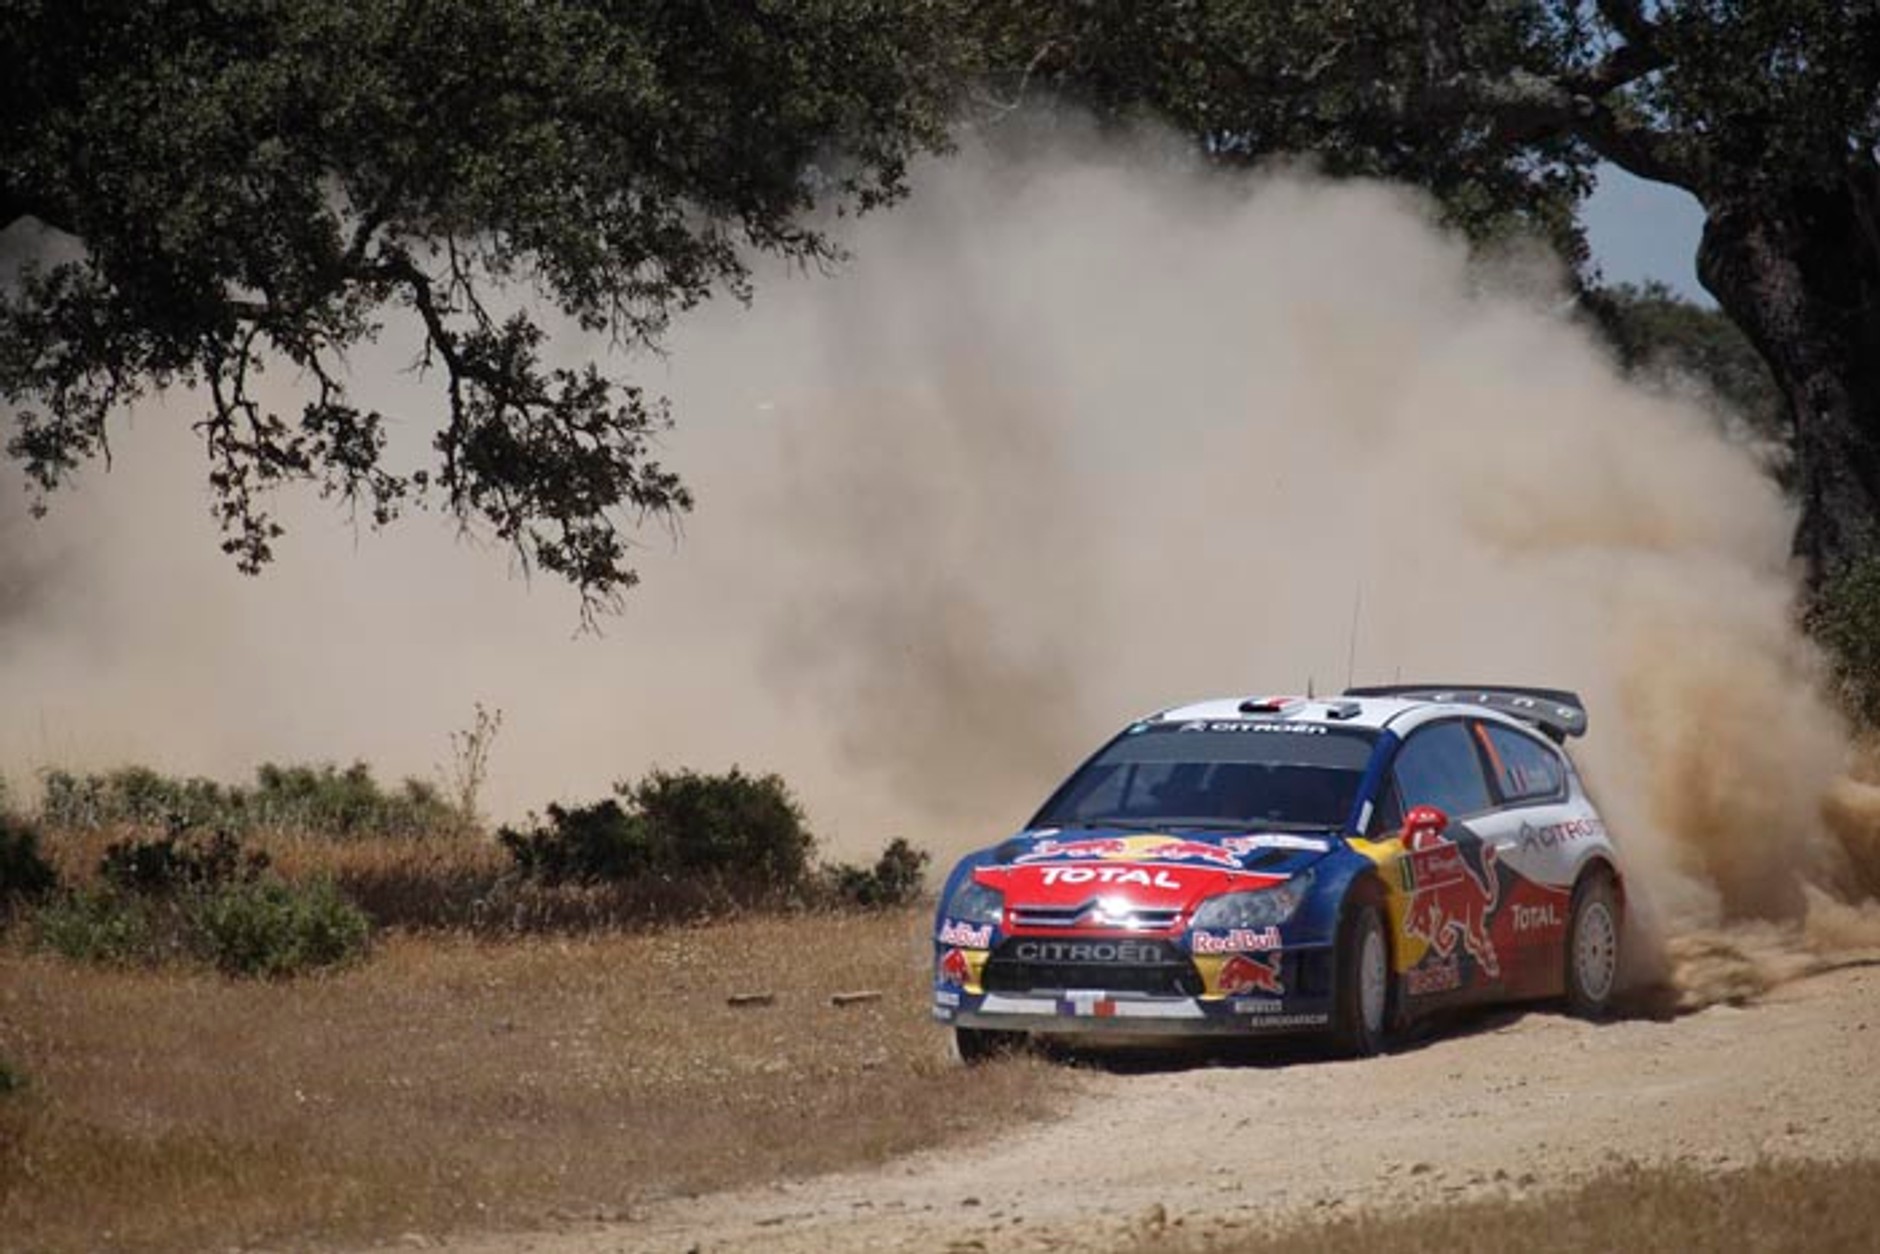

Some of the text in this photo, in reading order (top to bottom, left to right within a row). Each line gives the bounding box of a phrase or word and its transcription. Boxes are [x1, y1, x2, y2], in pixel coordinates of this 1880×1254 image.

[1040, 867, 1181, 888] TOTAL
[1510, 902, 1562, 931] TOTAL
[1016, 939, 1162, 963] CITROËN
